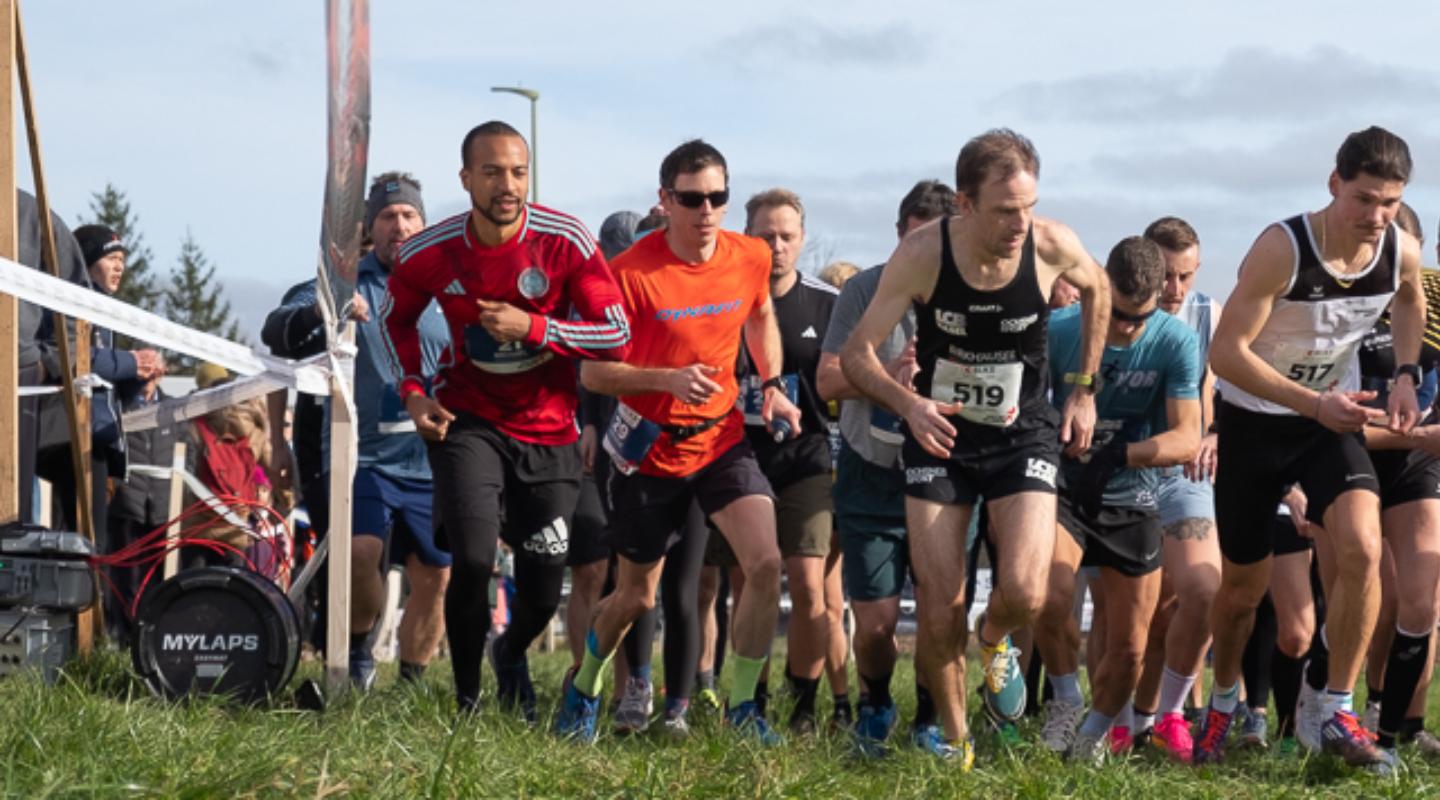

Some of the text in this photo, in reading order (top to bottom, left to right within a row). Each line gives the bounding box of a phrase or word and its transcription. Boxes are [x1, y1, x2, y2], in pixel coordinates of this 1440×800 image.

[1288, 362, 1334, 382] 517
[953, 382, 1004, 407] 519
[162, 633, 258, 650] MYLAPS
